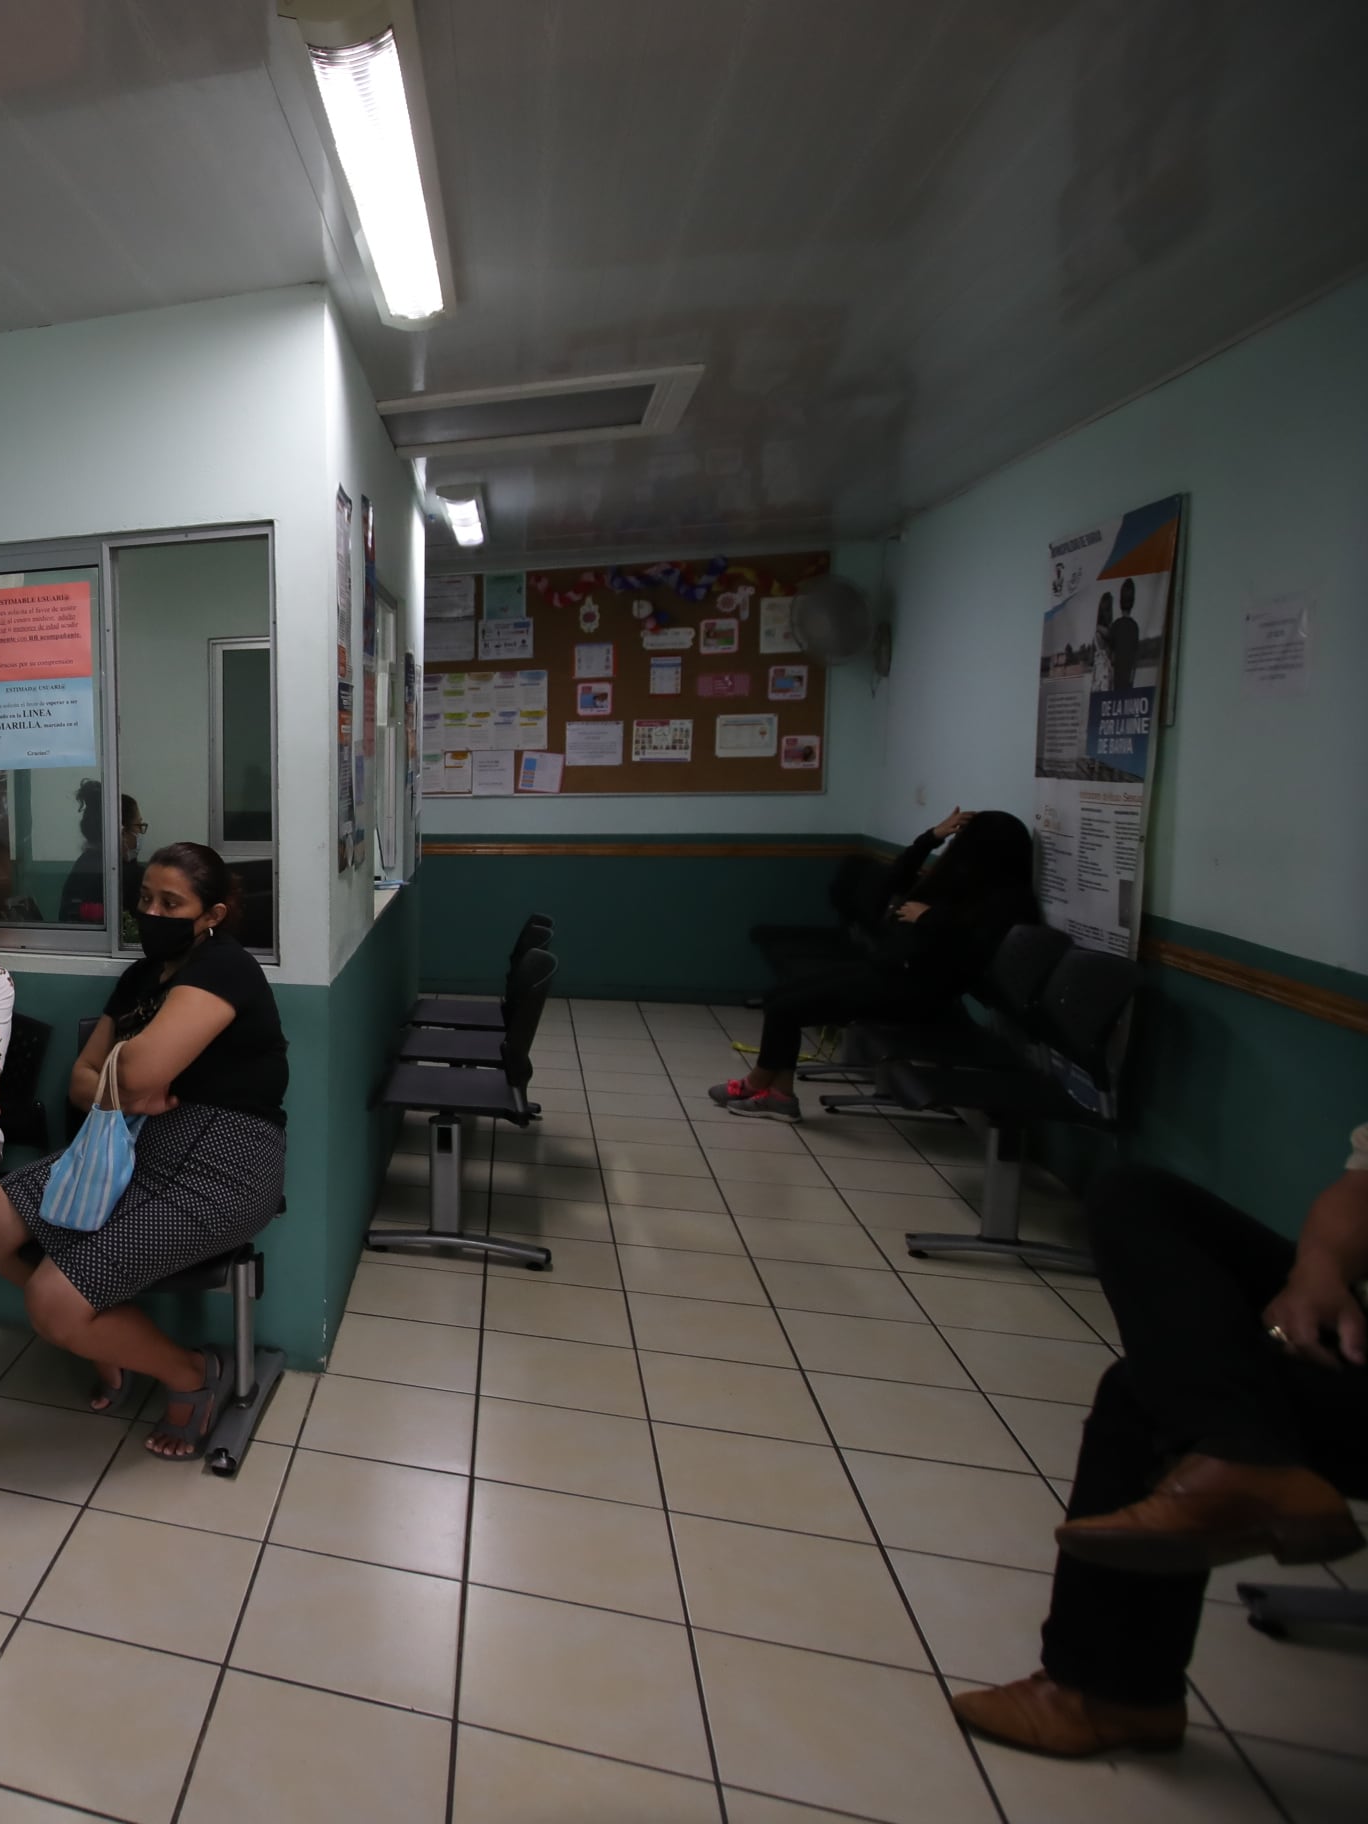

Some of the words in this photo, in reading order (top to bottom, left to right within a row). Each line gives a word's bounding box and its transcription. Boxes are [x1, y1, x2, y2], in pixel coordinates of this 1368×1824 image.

[23, 709, 51, 718] LINEA
[1102, 701, 1111, 716] DE
[1112, 700, 1122, 716] LA
[1099, 719, 1114, 735] POR
[1097, 738, 1108, 754] DE
